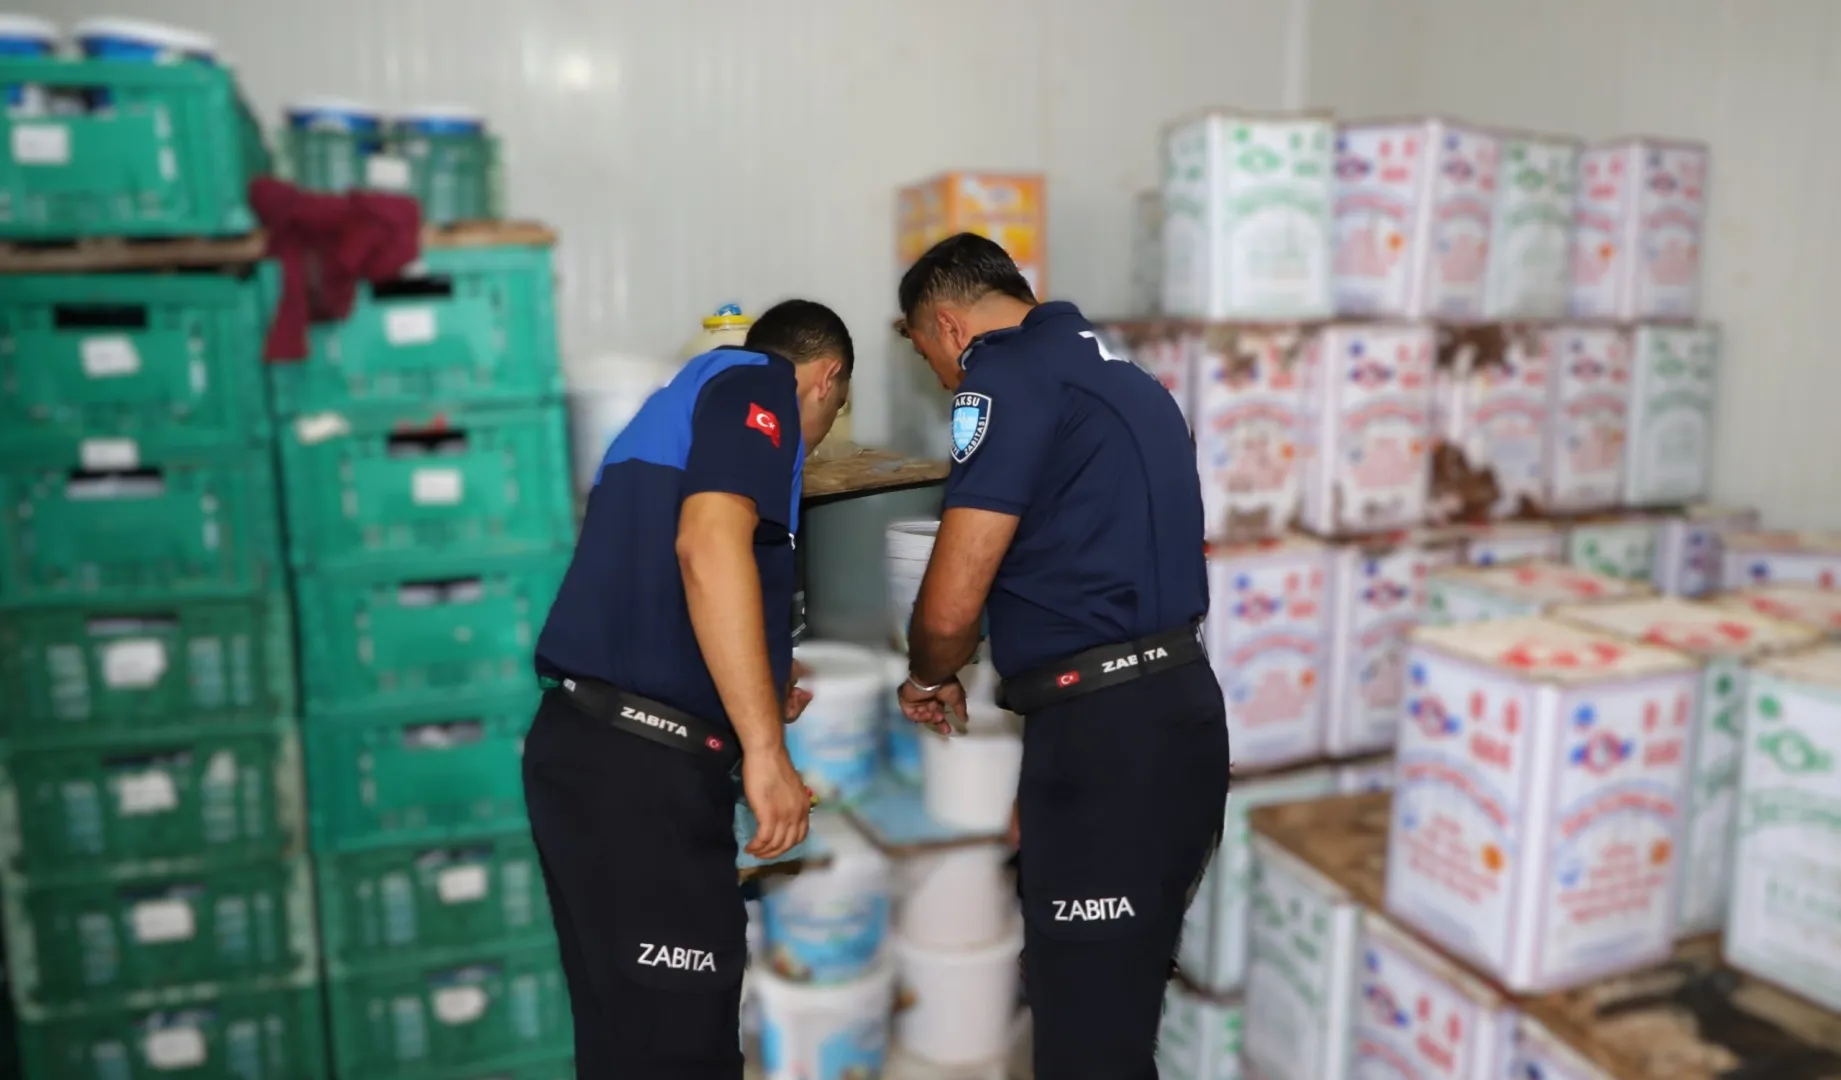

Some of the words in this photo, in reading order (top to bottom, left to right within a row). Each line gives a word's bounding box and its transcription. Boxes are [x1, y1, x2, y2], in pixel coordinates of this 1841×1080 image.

[955, 396, 980, 408] AKSU
[964, 416, 987, 456] ZABITASI
[620, 706, 688, 737] ZABITA
[1052, 896, 1135, 921] ZABITA
[637, 942, 716, 972] ZABITA
